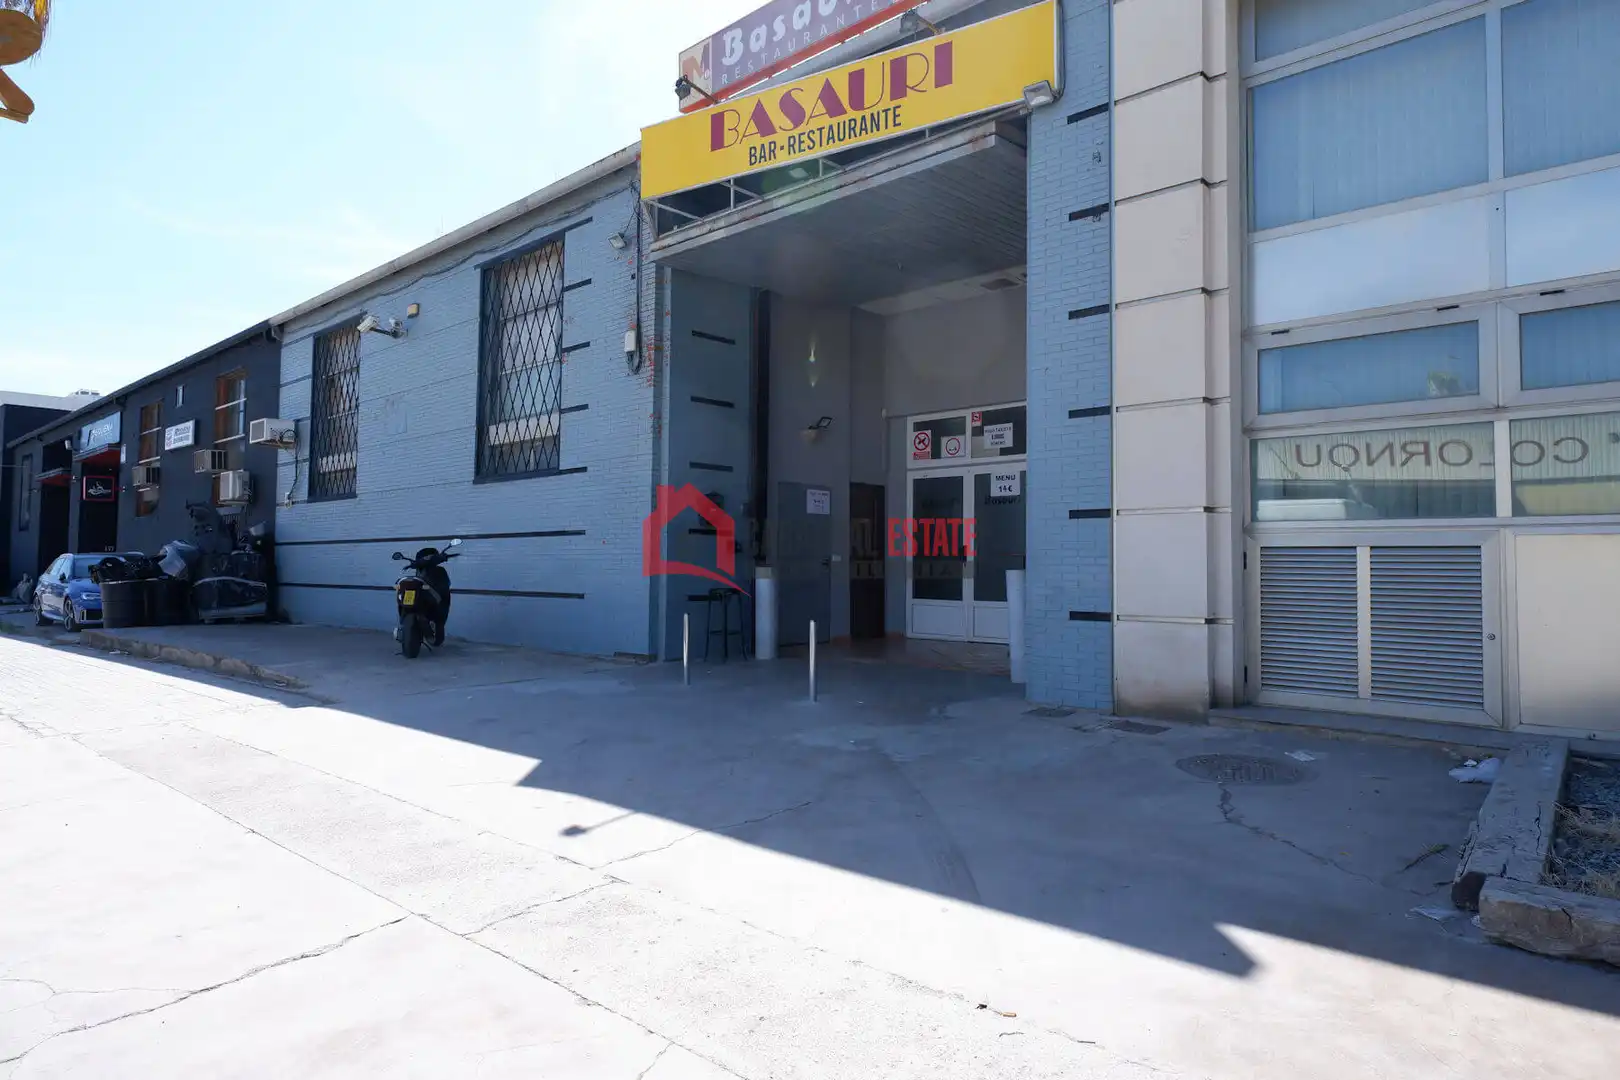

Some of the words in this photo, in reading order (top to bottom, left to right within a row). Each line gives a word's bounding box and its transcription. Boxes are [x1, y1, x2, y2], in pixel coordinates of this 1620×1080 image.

[721, 0, 852, 66] Basau
[721, 0, 878, 84] RESTAURANTE
[710, 41, 953, 152] BASAURI
